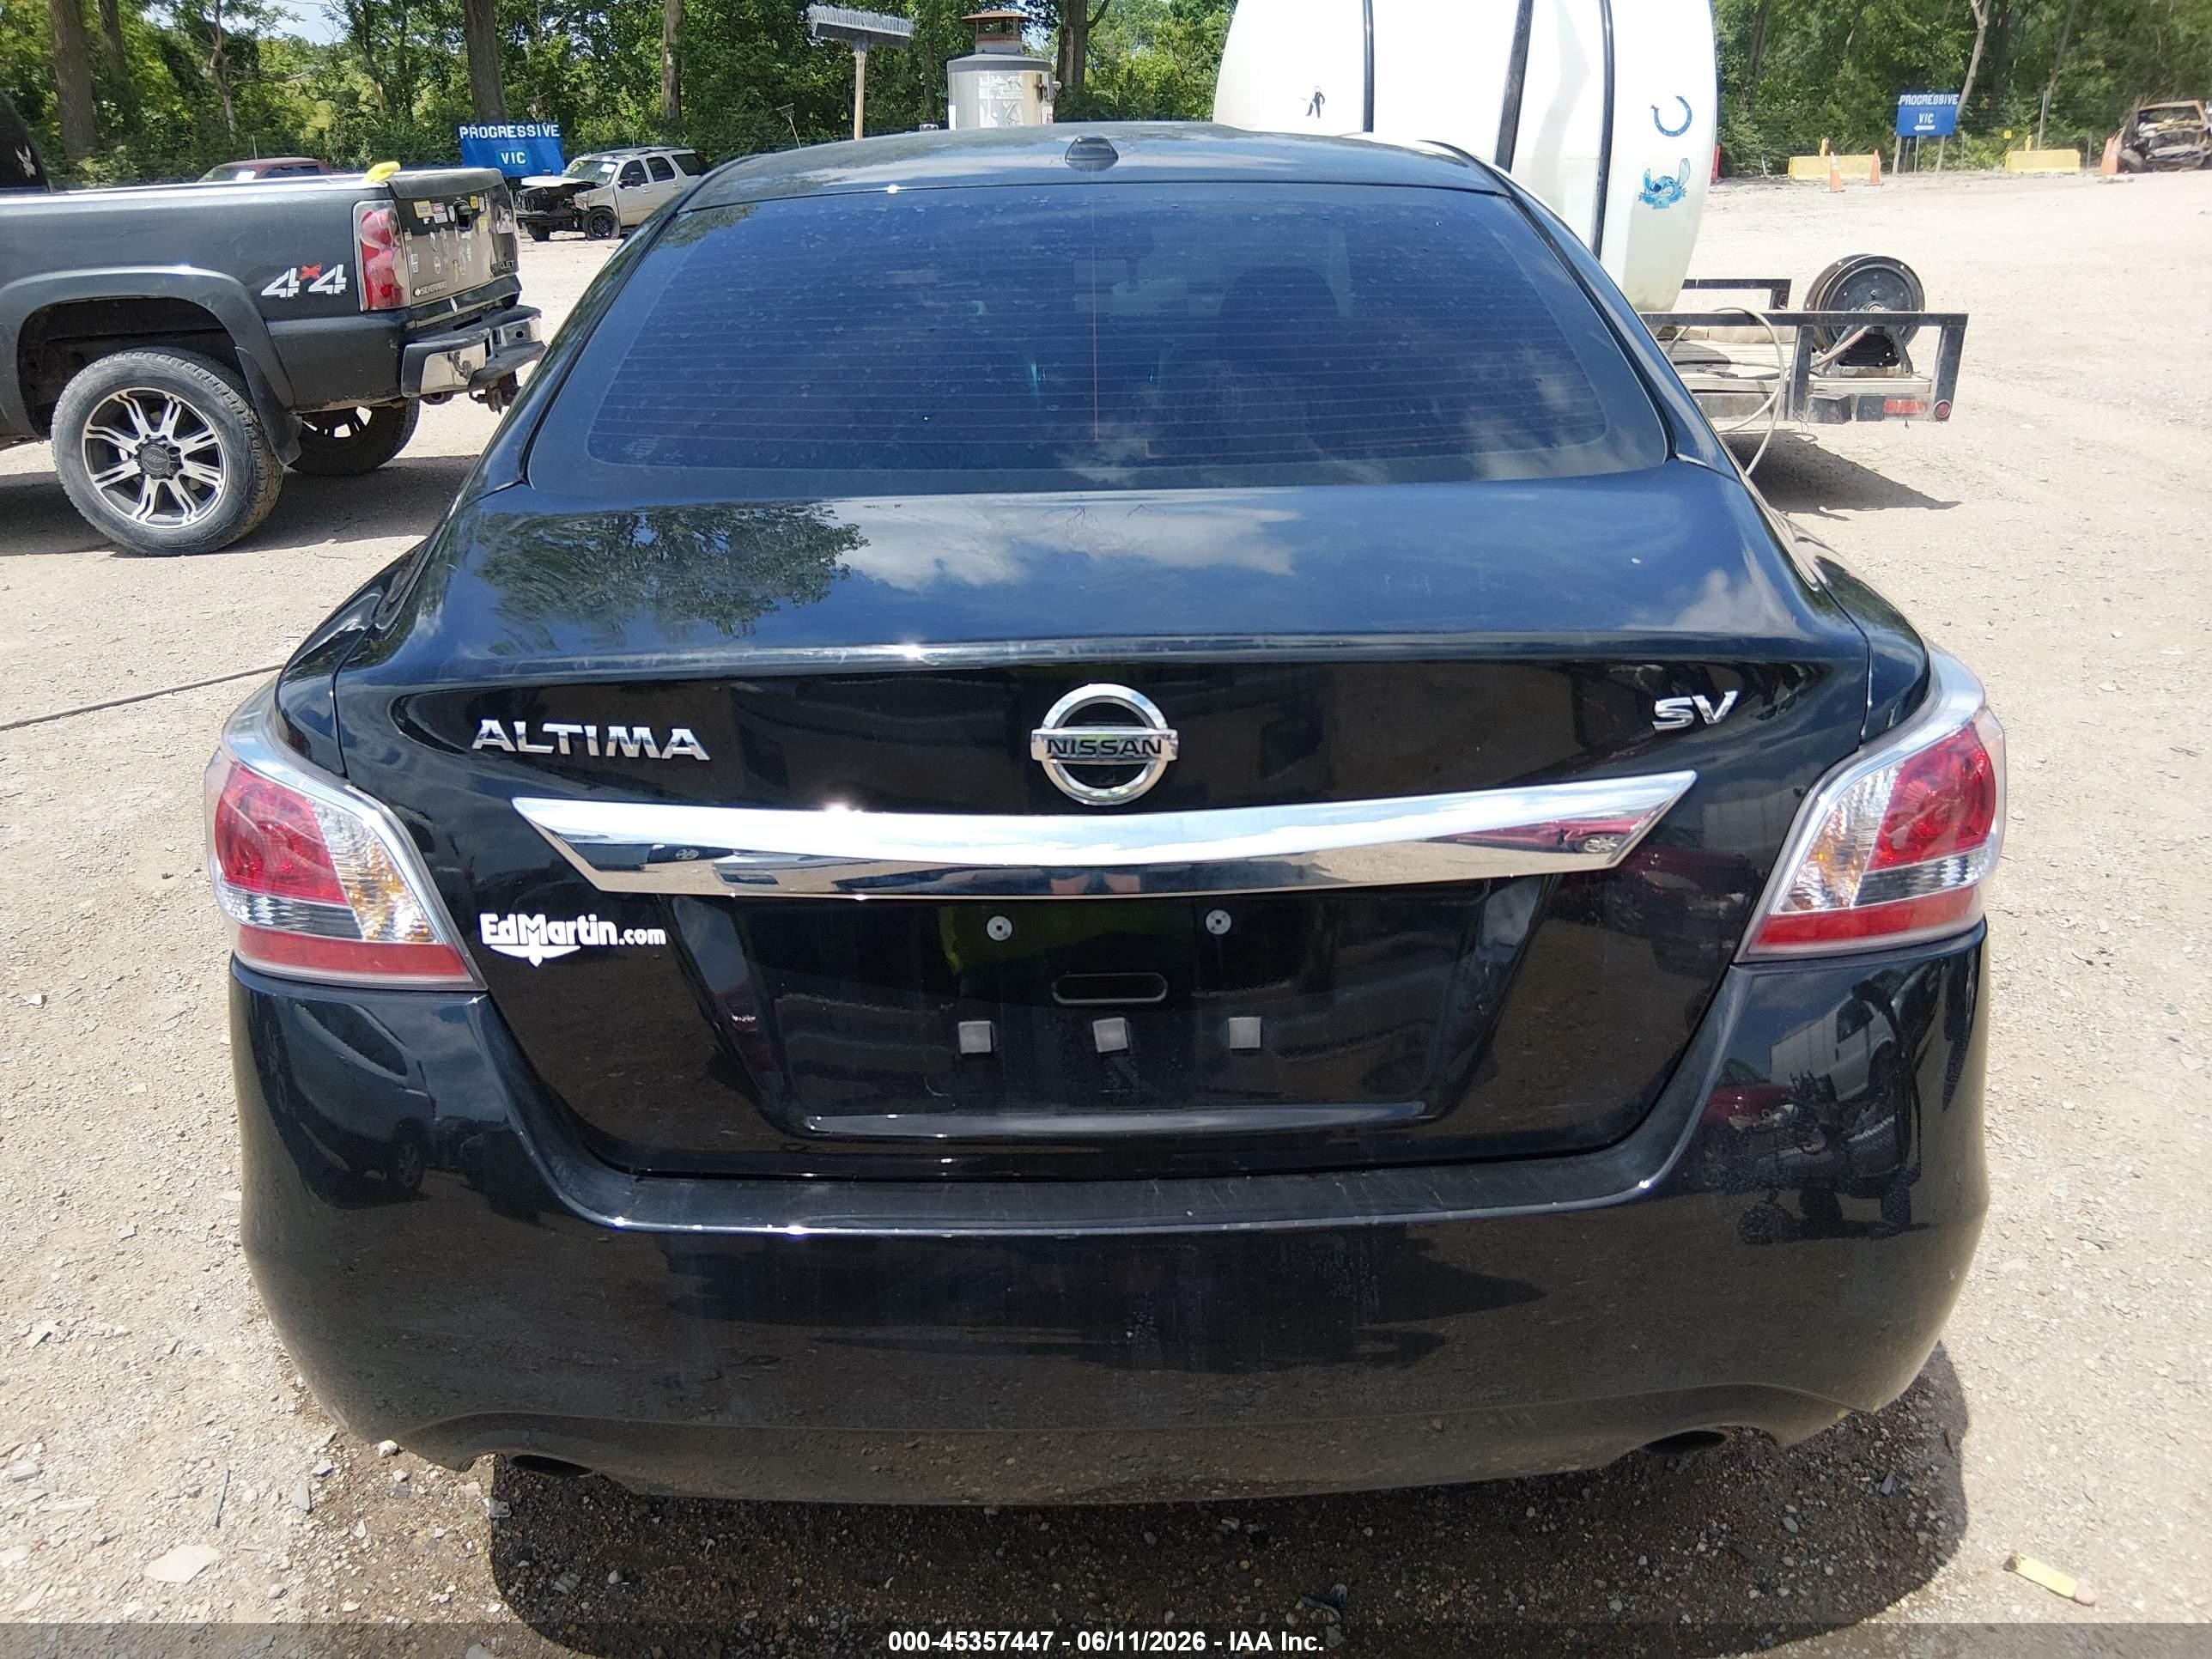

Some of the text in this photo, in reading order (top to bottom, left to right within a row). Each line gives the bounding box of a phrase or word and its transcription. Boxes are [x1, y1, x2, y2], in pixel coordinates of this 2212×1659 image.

[1898, 94, 1959, 105] PROGRESSIVE
[1919, 113, 1934, 124] VIC
[459, 124, 561, 138] PROGRESSIVE
[501, 151, 526, 164] VIC
[1652, 690, 1738, 730] SV
[472, 720, 711, 761] ALTIMA
[1046, 738, 1162, 756] NISSAN
[479, 913, 667, 945] EdMartin.com
